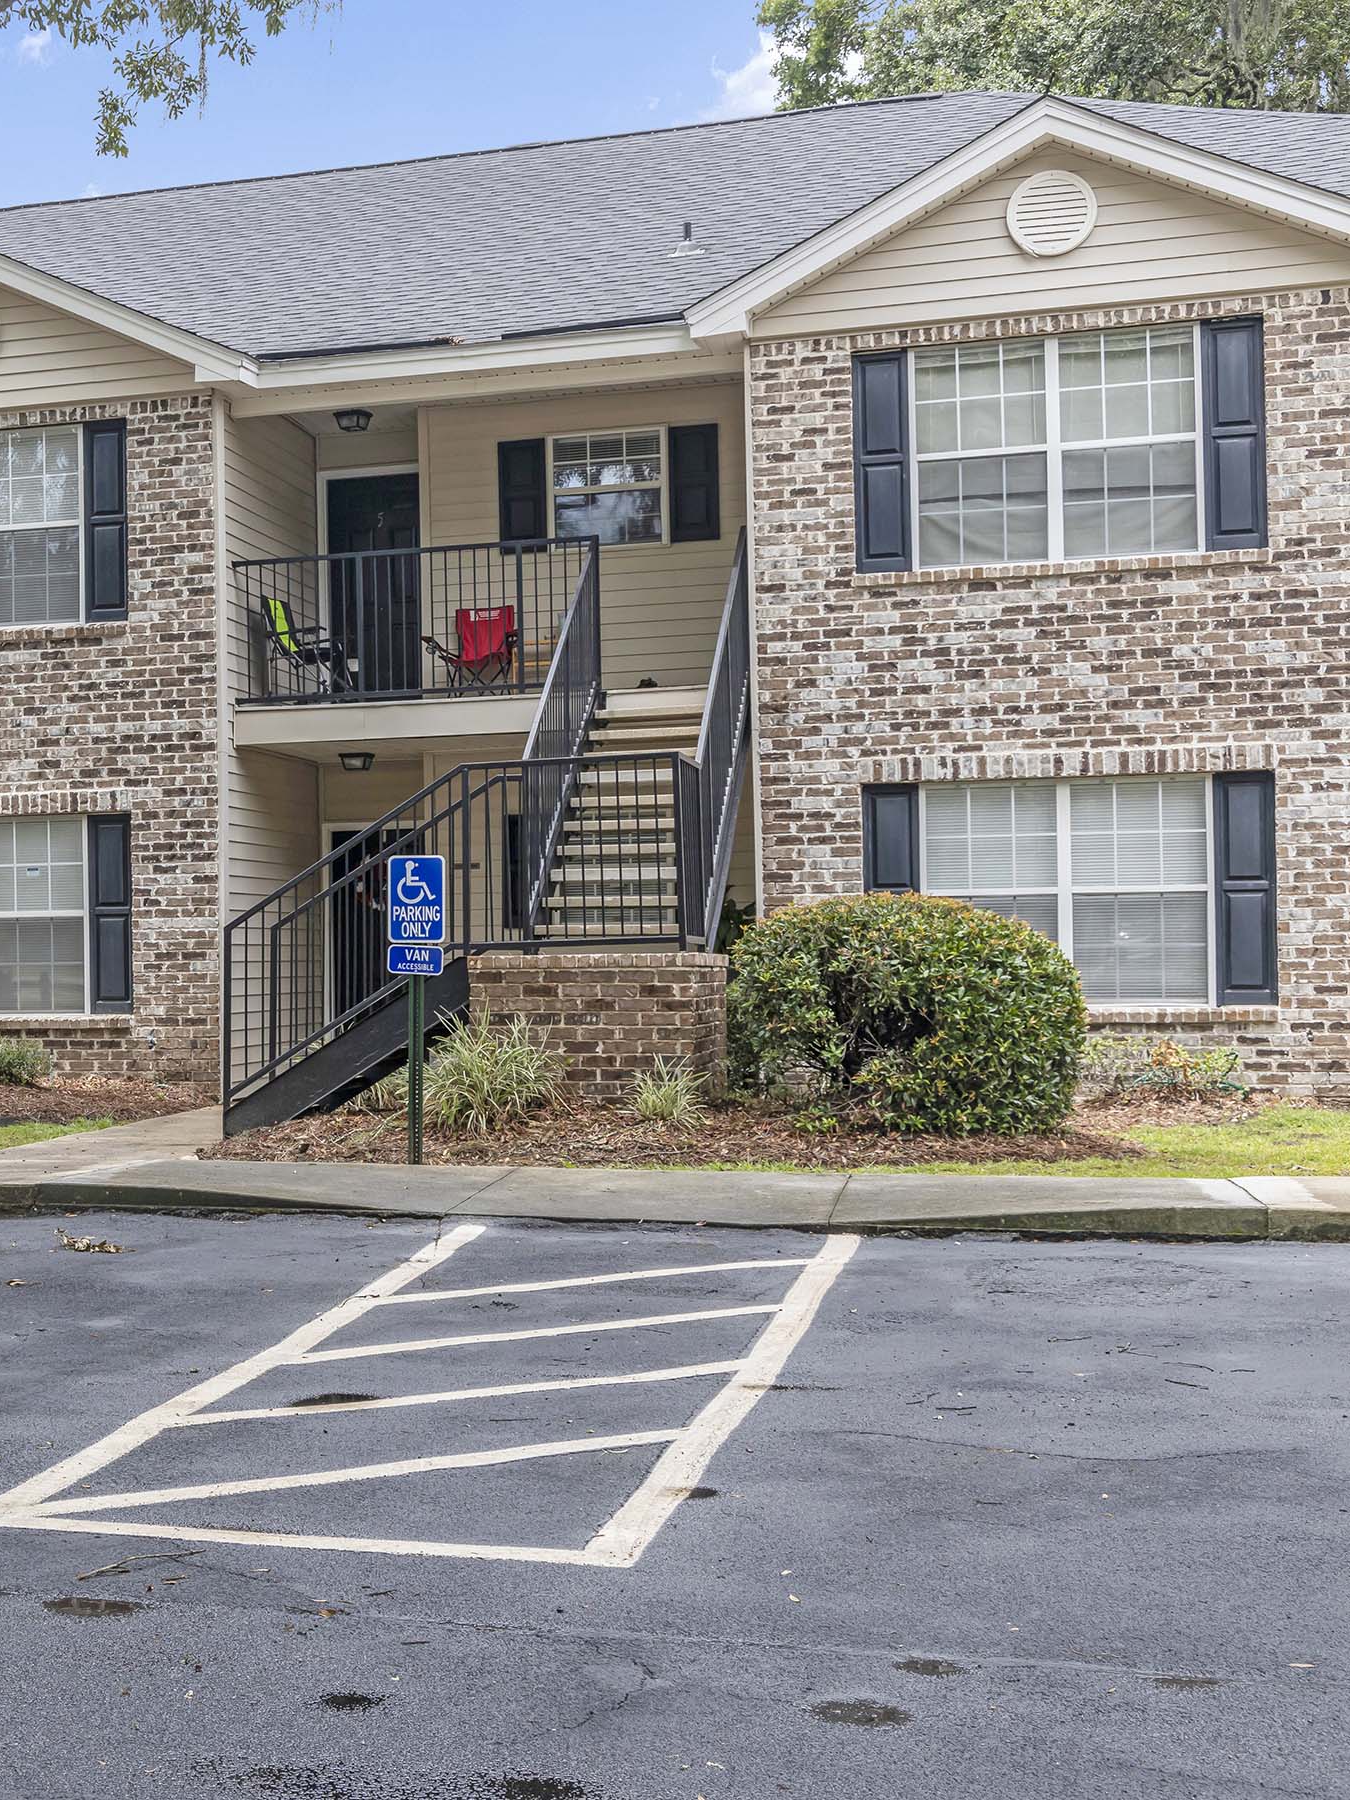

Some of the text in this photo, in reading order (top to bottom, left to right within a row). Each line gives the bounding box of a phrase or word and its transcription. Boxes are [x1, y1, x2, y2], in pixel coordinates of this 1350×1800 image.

[393, 906, 440, 921] PARKING
[401, 922, 432, 938] ONLY
[405, 949, 429, 962] VAN
[397, 963, 434, 972] ACCESSIBLE
